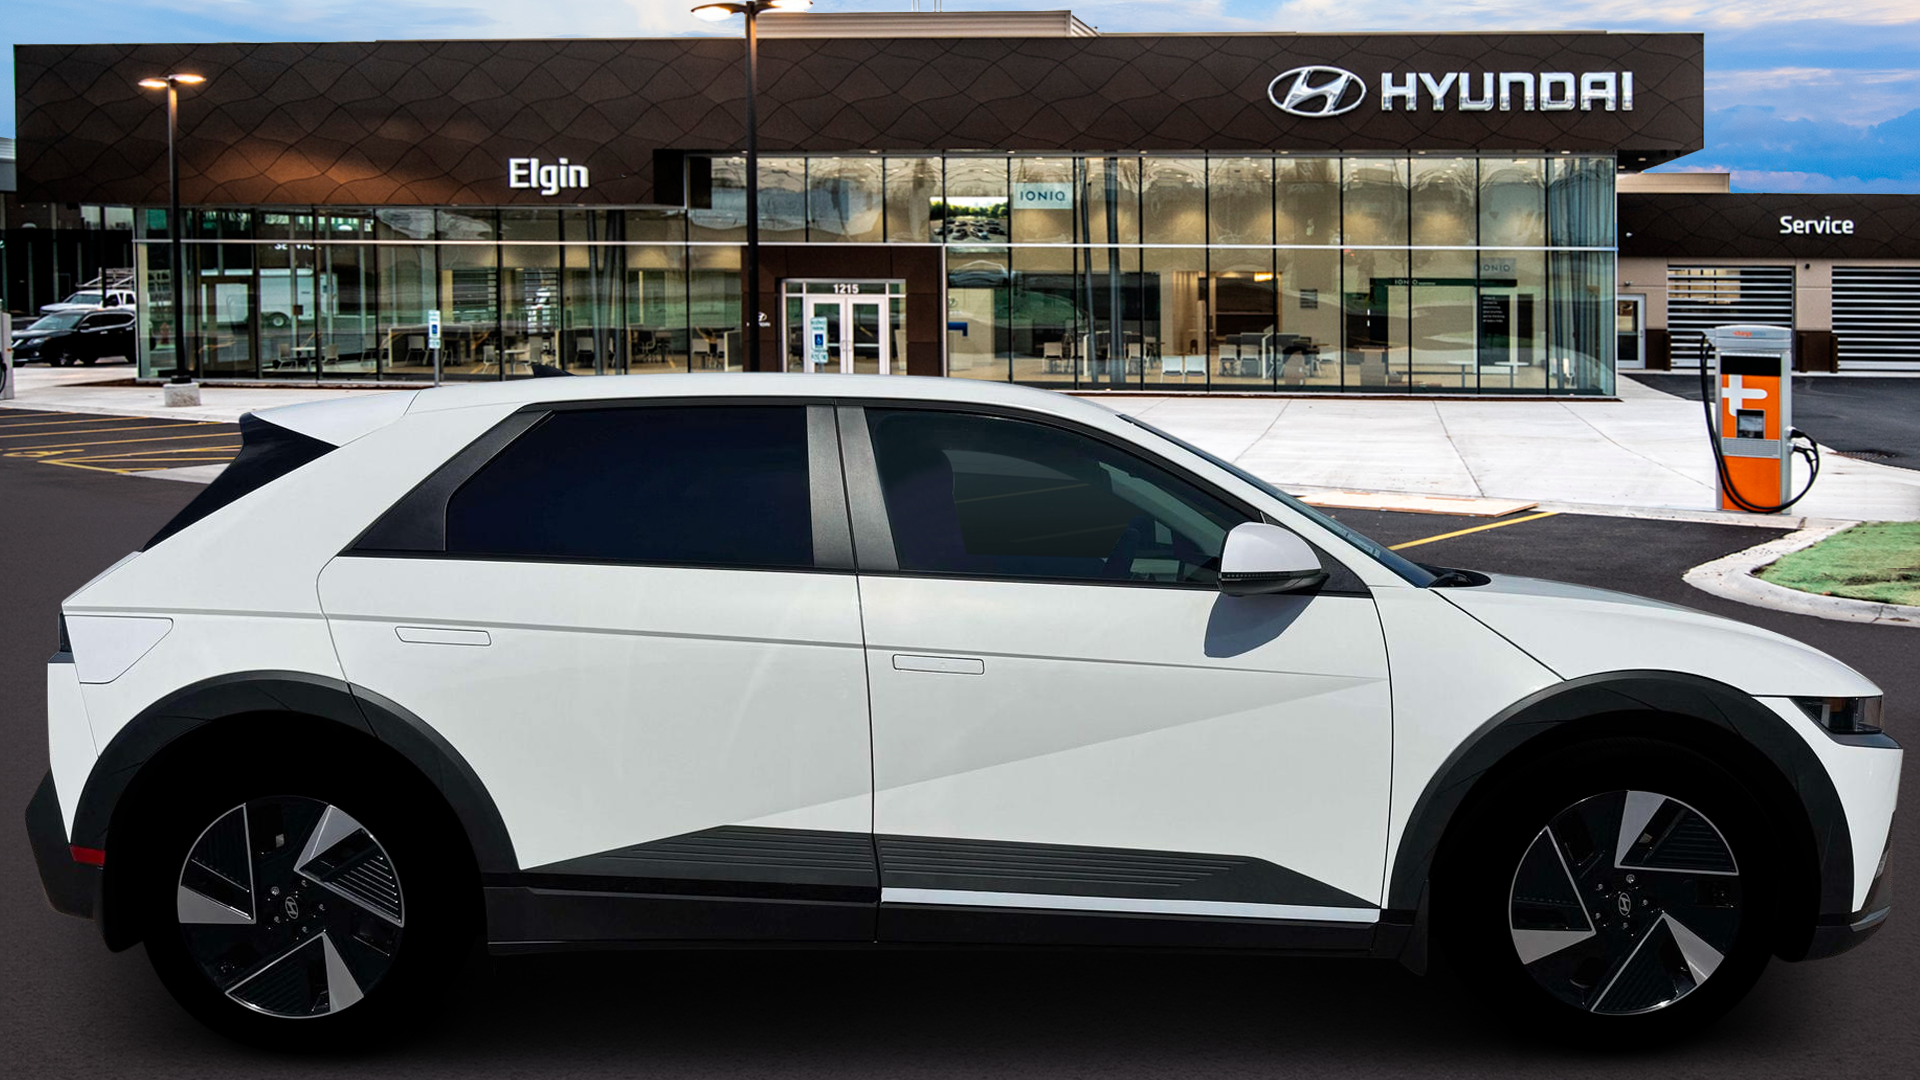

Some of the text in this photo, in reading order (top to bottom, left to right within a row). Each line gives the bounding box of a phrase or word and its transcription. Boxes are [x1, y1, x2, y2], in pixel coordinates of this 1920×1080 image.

[1381, 72, 1633, 111] HYUNDAI
[508, 157, 589, 196] Elgin
[1020, 190, 1065, 202] IONIQ
[1780, 215, 1854, 235] Service
[833, 283, 859, 294] 1215
